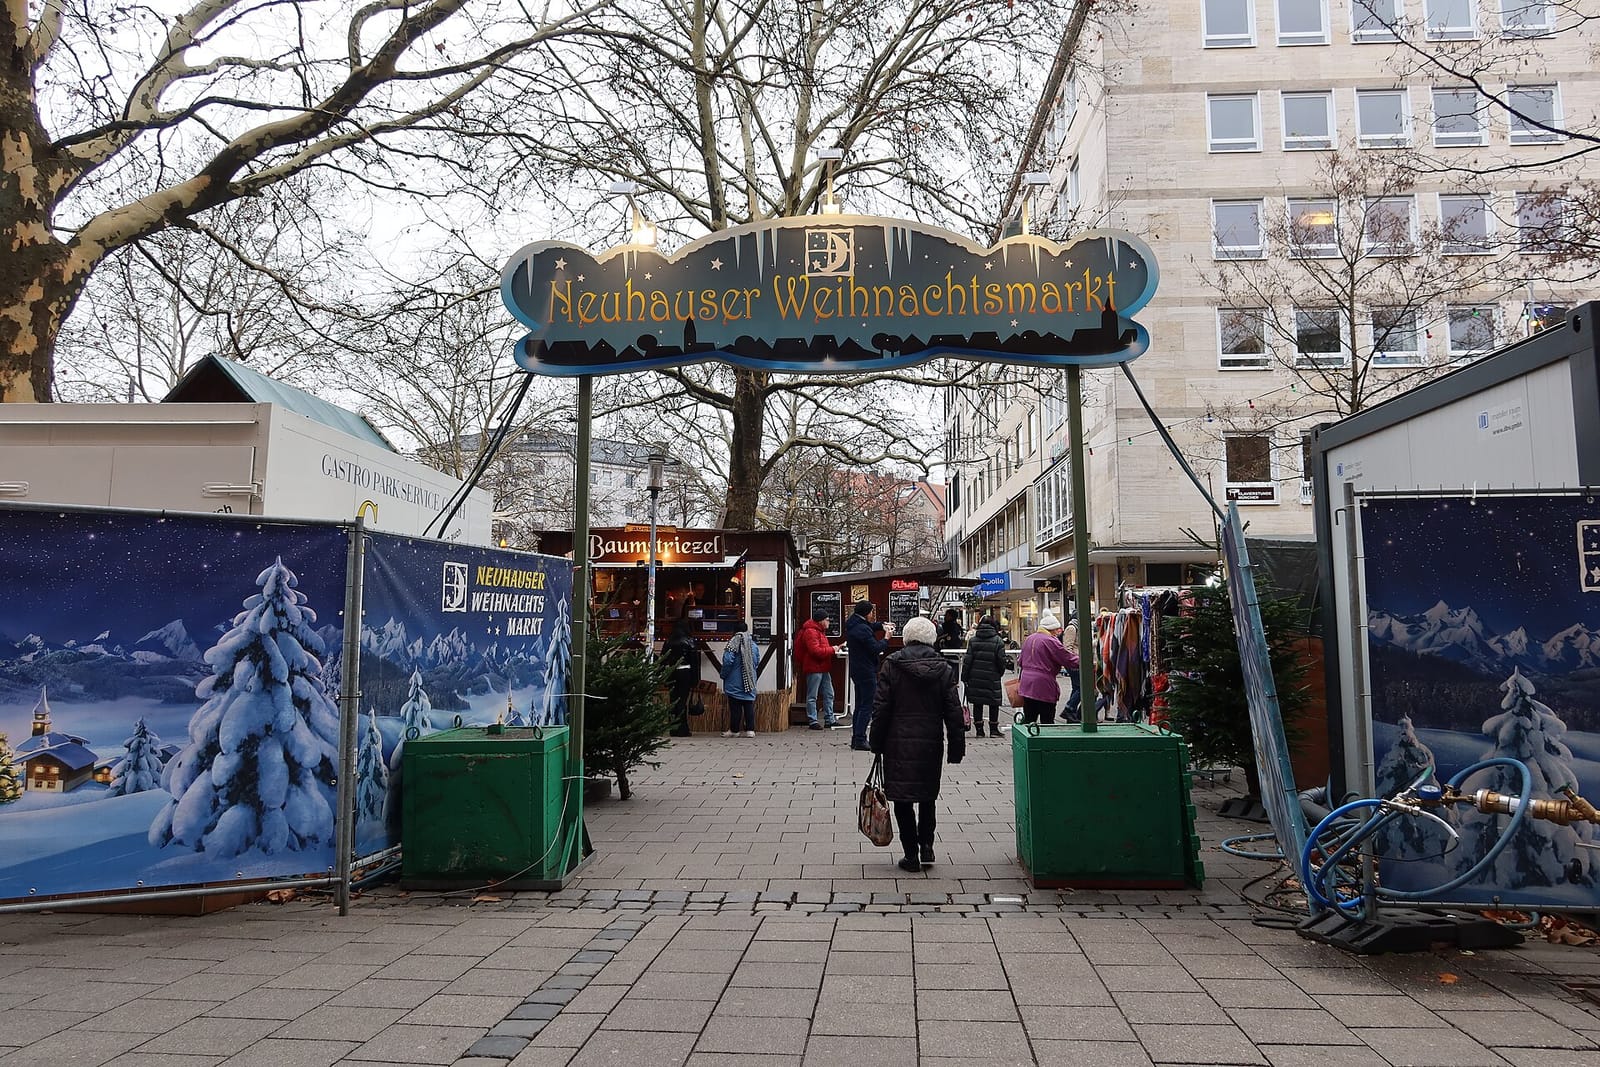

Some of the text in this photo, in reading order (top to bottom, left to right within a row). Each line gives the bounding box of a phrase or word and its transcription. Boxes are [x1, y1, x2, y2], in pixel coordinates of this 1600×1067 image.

[547, 268, 1117, 328] Neuhauser Weihnachtsmarkt
[322, 454, 371, 488] GASTRO
[373, 472, 401, 499] PARK
[401, 484, 440, 512] SERVICE
[476, 566, 545, 590] NEUHAUSER
[471, 592, 545, 613] WEIHNACHTS
[506, 617, 544, 636] MARKT
